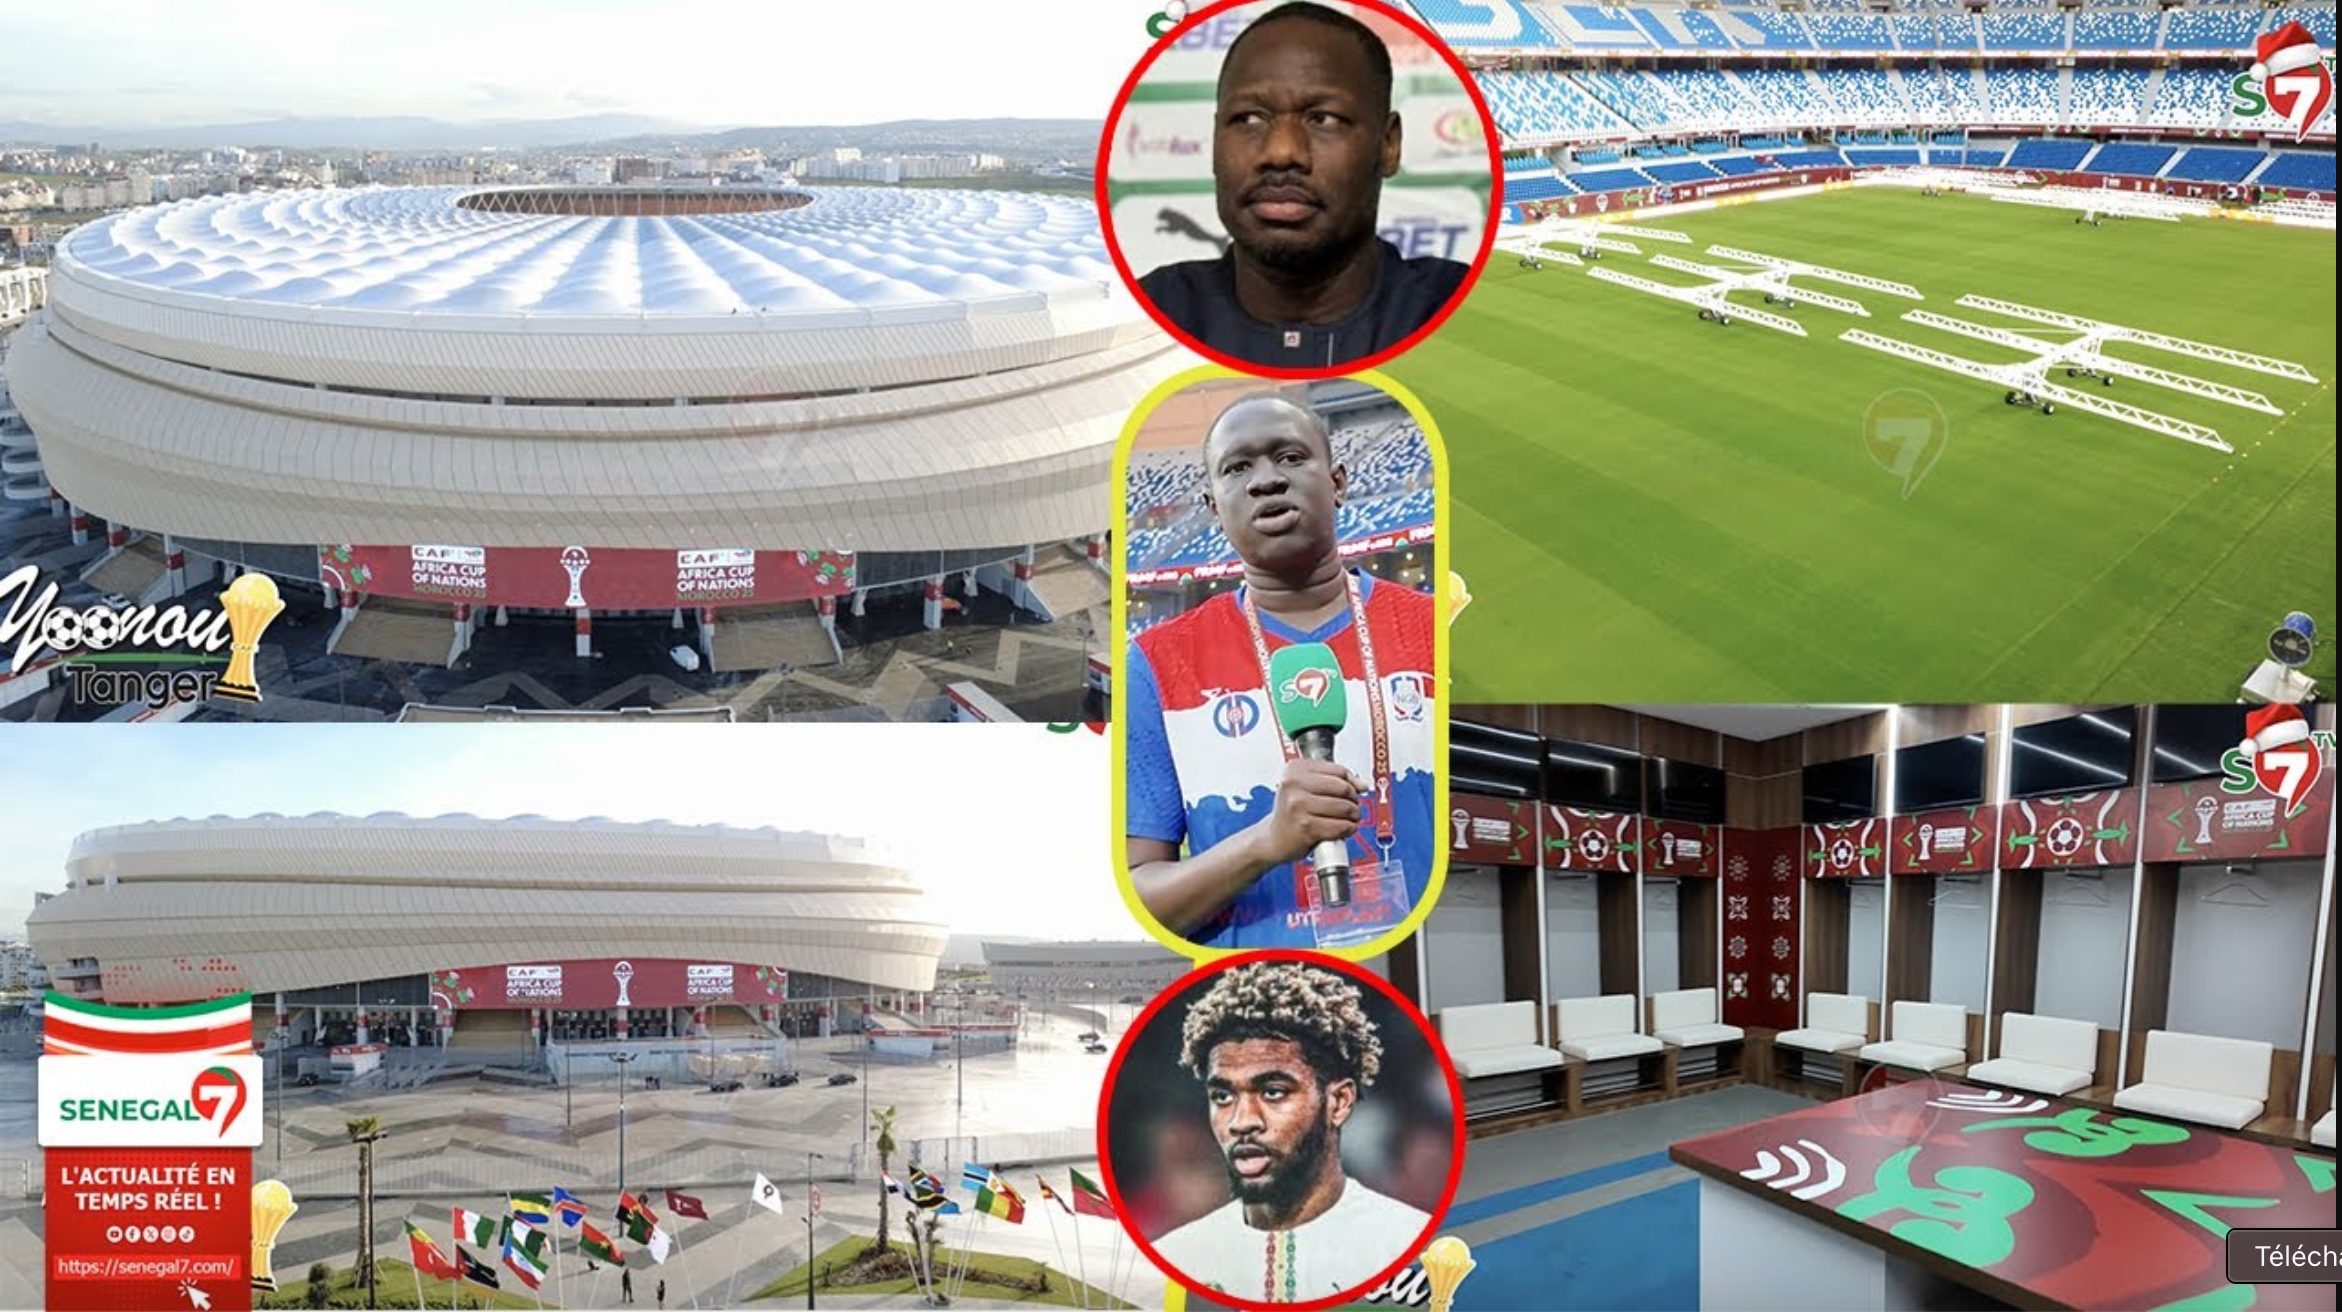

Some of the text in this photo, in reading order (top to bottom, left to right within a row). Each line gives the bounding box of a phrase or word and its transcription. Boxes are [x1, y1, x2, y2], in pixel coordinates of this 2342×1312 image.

[413, 547, 450, 558] CAF
[680, 553, 719, 564] CAF
[412, 561, 486, 577] AFRICA CUP
[677, 566, 755, 580] AFRICA CUP
[412, 572, 486, 588] OF NATIONS
[677, 577, 755, 592] OF NATIONS
[1370, 702, 1387, 759] MOROCCO
[507, 979, 562, 988] AFRICA CUP
[507, 988, 562, 997] OF NATIONS
[688, 986, 733, 995] OF NATIONS
